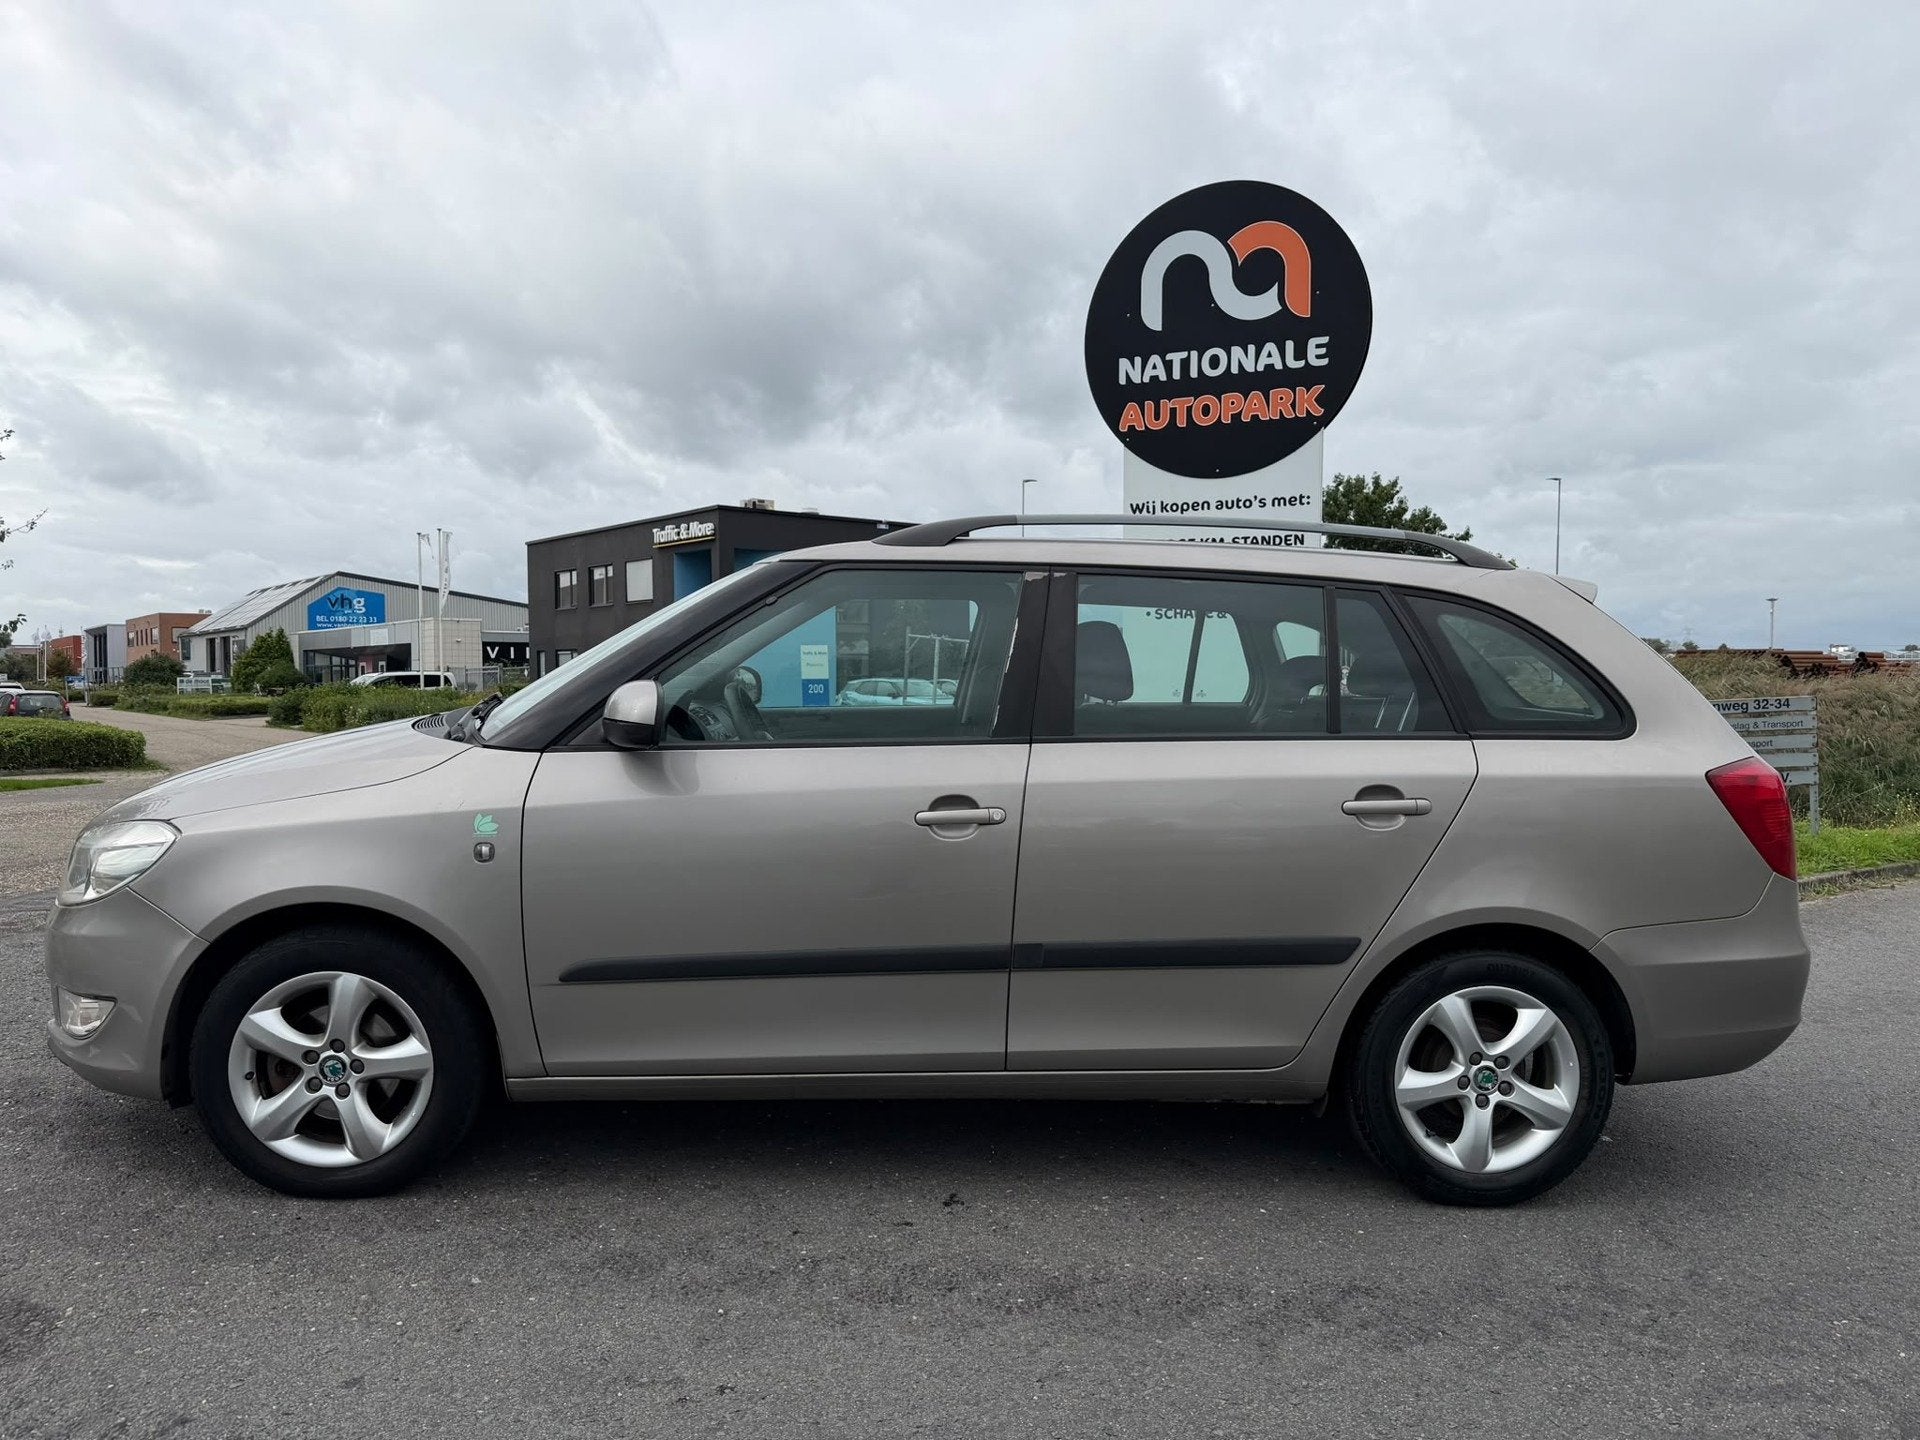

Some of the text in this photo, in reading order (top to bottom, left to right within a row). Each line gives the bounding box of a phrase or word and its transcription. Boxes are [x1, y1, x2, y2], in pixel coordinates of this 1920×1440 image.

[1118, 336, 1330, 385] NATIONALE
[1119, 385, 1326, 432] AUTOPARK
[1130, 493, 1312, 515] Wij kopen auto's met:
[652, 521, 715, 543] Traffic & More
[327, 593, 366, 613] vhg
[808, 684, 824, 694] 200
[1753, 699, 1791, 710] 32-34
[1761, 720, 1804, 730] Transport
